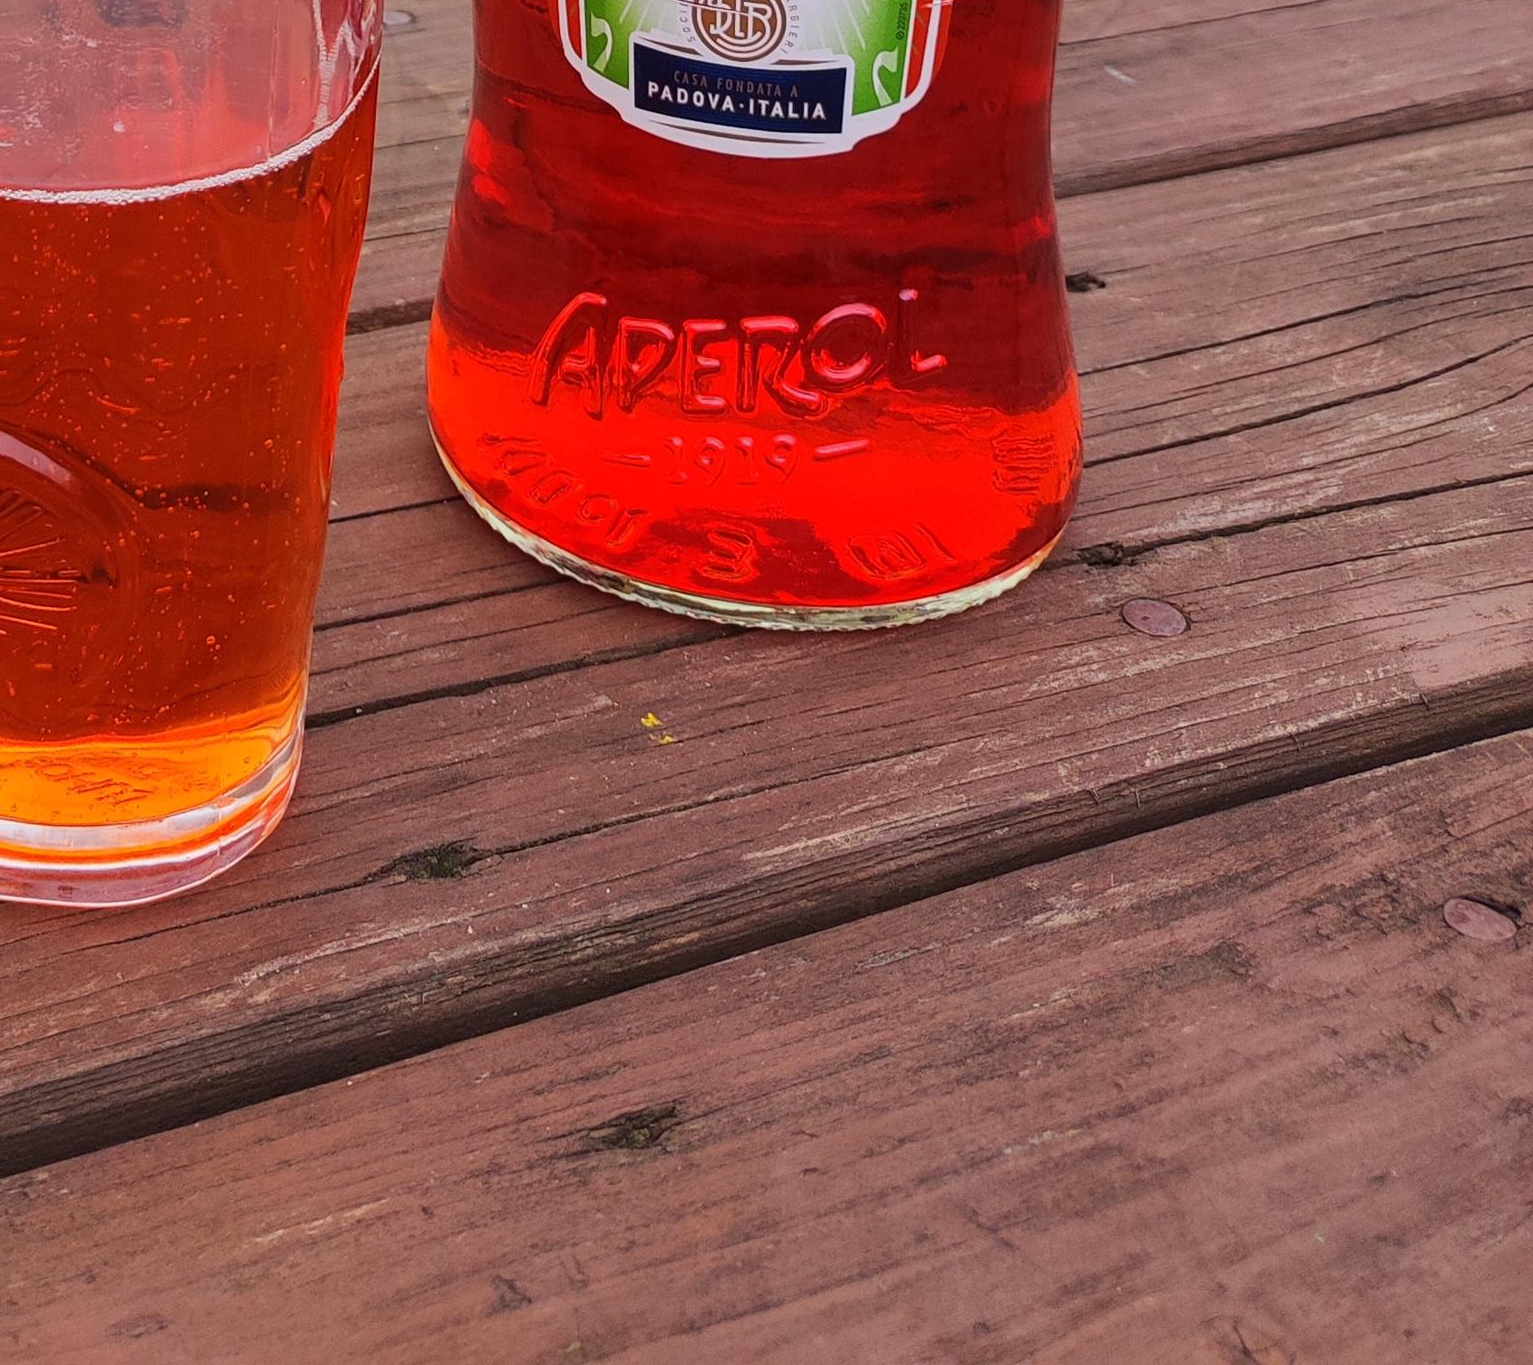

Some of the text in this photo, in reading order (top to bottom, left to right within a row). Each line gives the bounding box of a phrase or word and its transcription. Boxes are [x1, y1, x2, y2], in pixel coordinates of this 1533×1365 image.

[674, 70, 799, 98] CASA FONDATA A
[529, 289, 947, 421] APEROL
